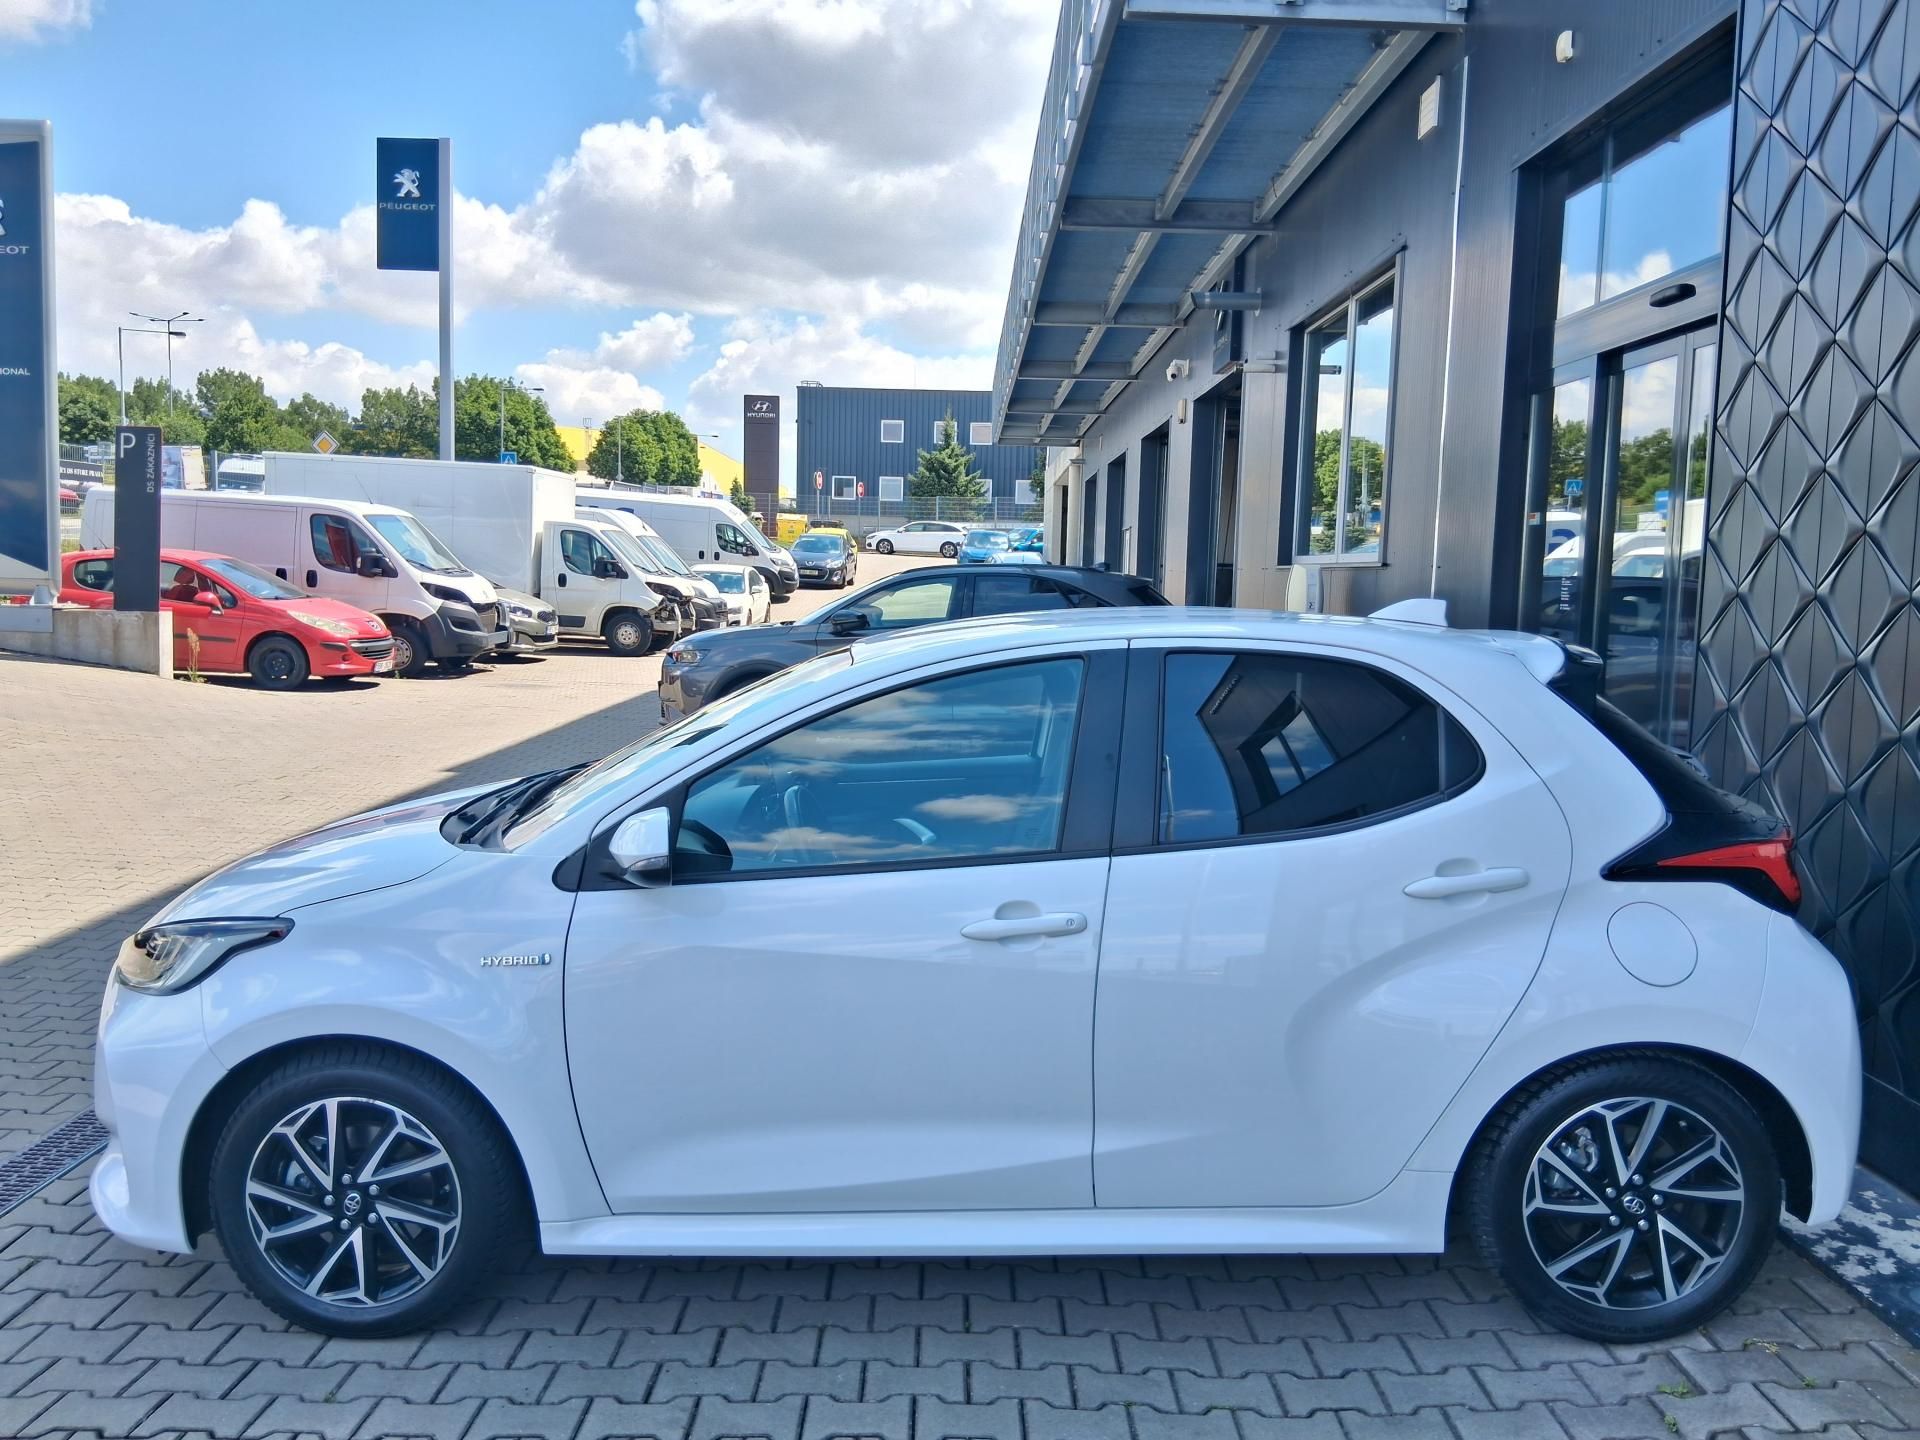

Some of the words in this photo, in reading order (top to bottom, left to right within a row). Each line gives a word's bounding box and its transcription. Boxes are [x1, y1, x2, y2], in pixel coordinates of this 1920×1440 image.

[379, 202, 436, 211] PEUGEOT
[120, 432, 136, 458] P
[147, 481, 155, 493] DS
[480, 955, 540, 967] HYBRID
